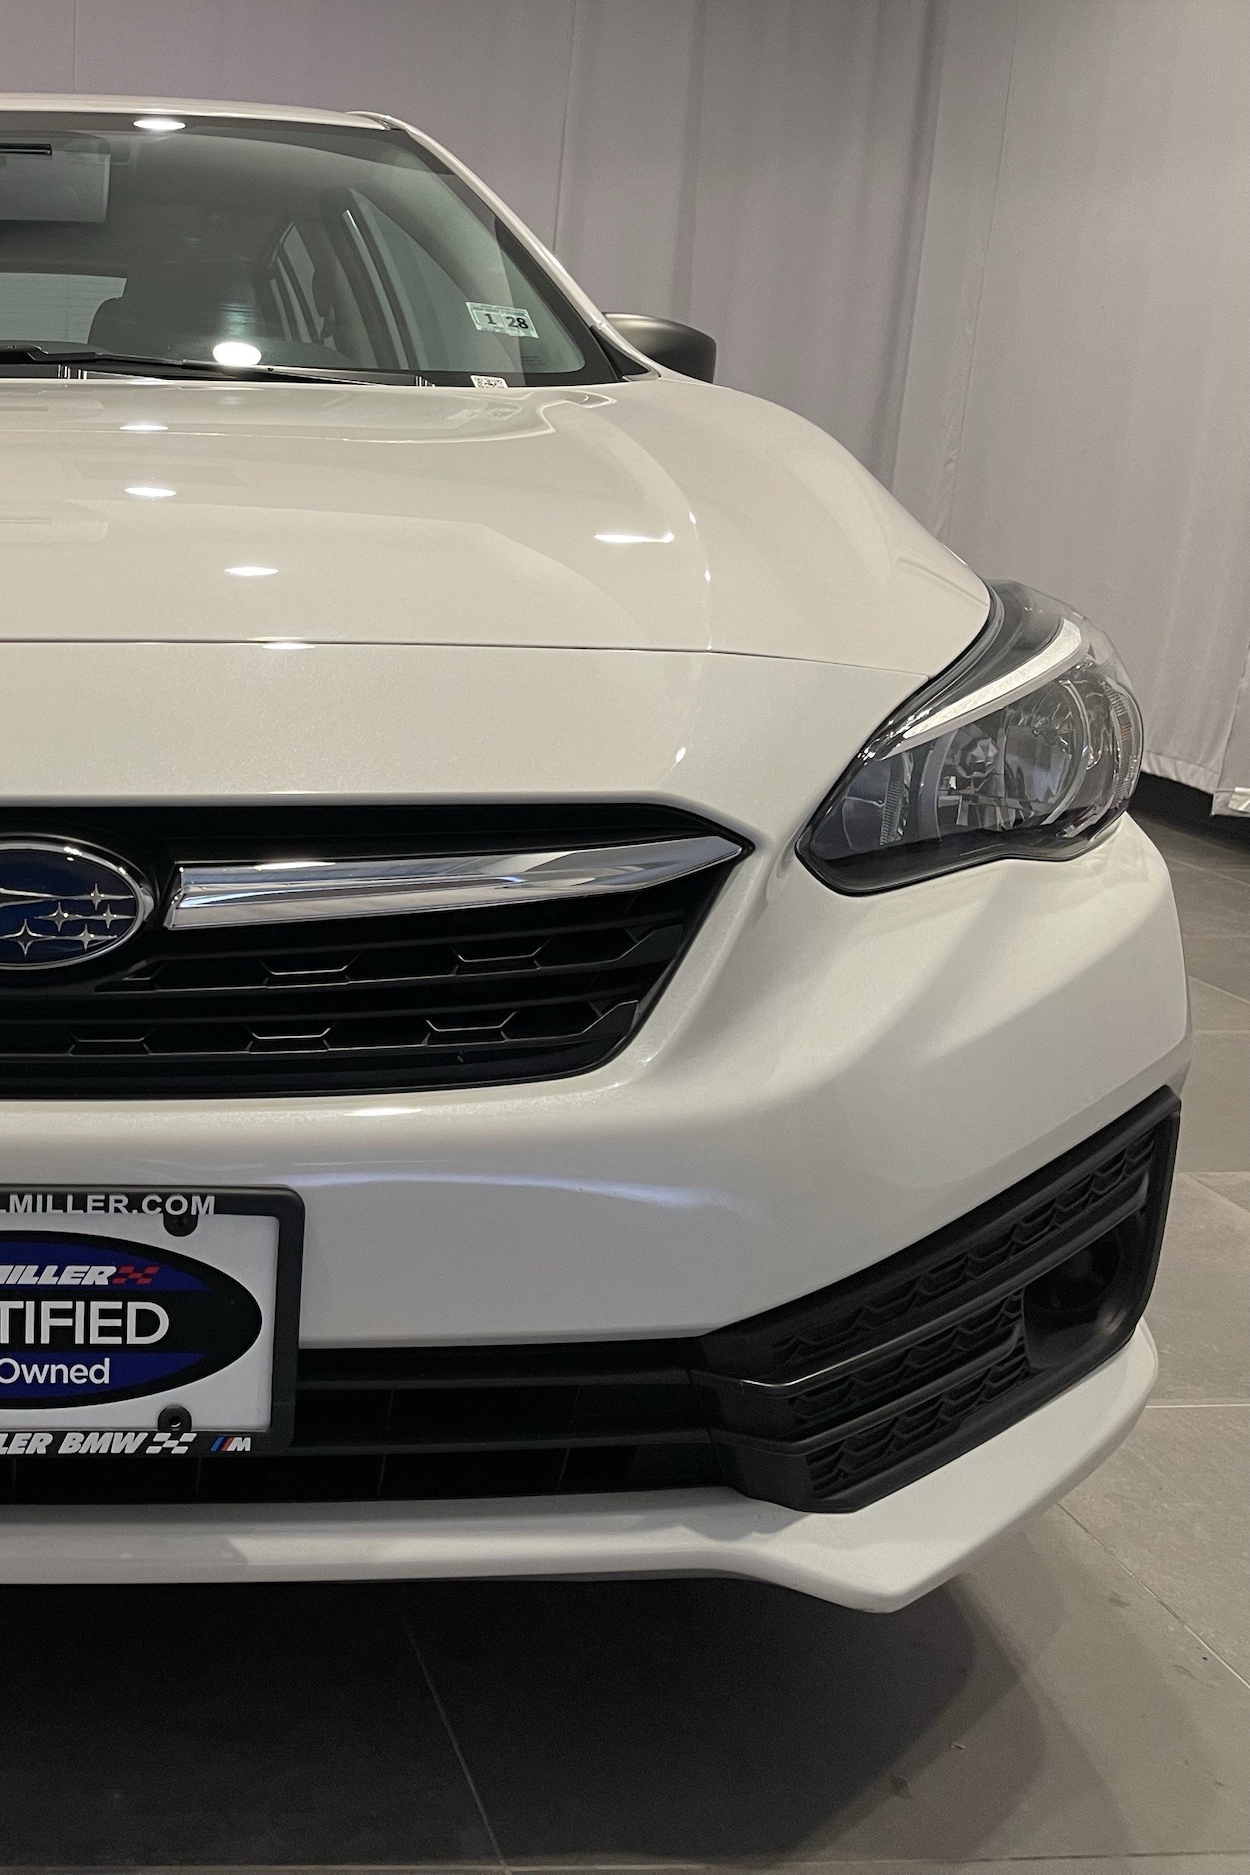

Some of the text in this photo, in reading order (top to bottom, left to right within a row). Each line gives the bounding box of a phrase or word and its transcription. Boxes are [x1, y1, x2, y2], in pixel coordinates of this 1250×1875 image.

[485, 313, 529, 329] 1 28
[57, 1432, 148, 1454] BMW
